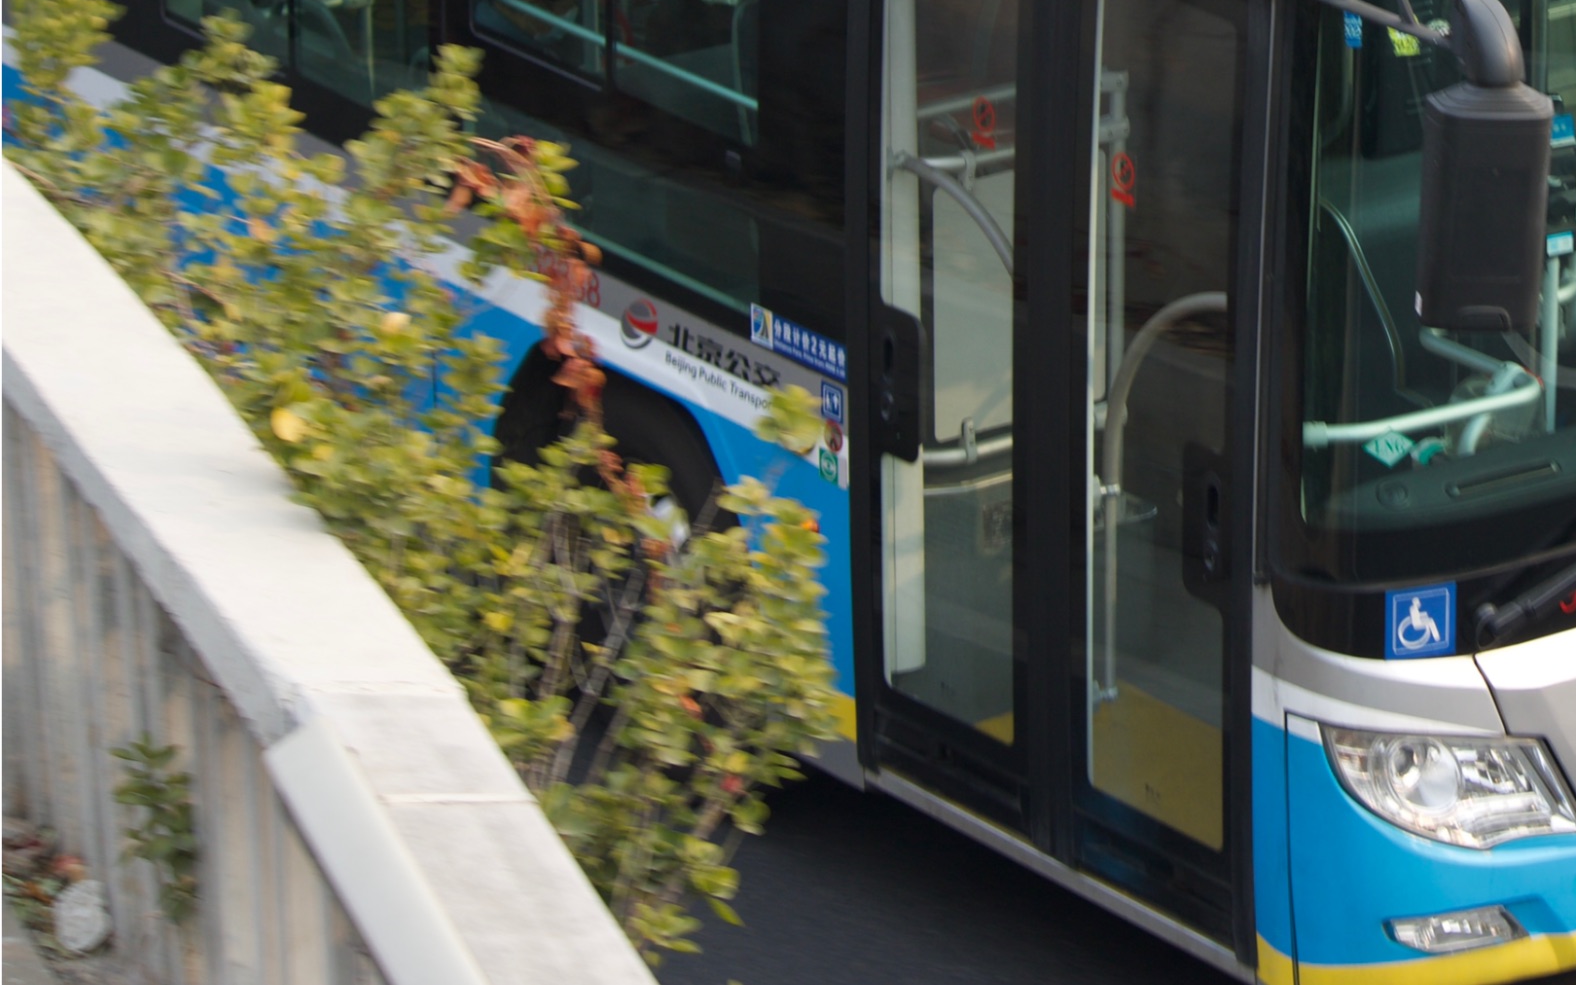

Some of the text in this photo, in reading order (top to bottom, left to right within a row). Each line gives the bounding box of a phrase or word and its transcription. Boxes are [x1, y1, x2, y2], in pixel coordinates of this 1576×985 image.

[665, 350, 773, 410] Beijing Public Transpor
[668, 323, 781, 387] 北京公交
